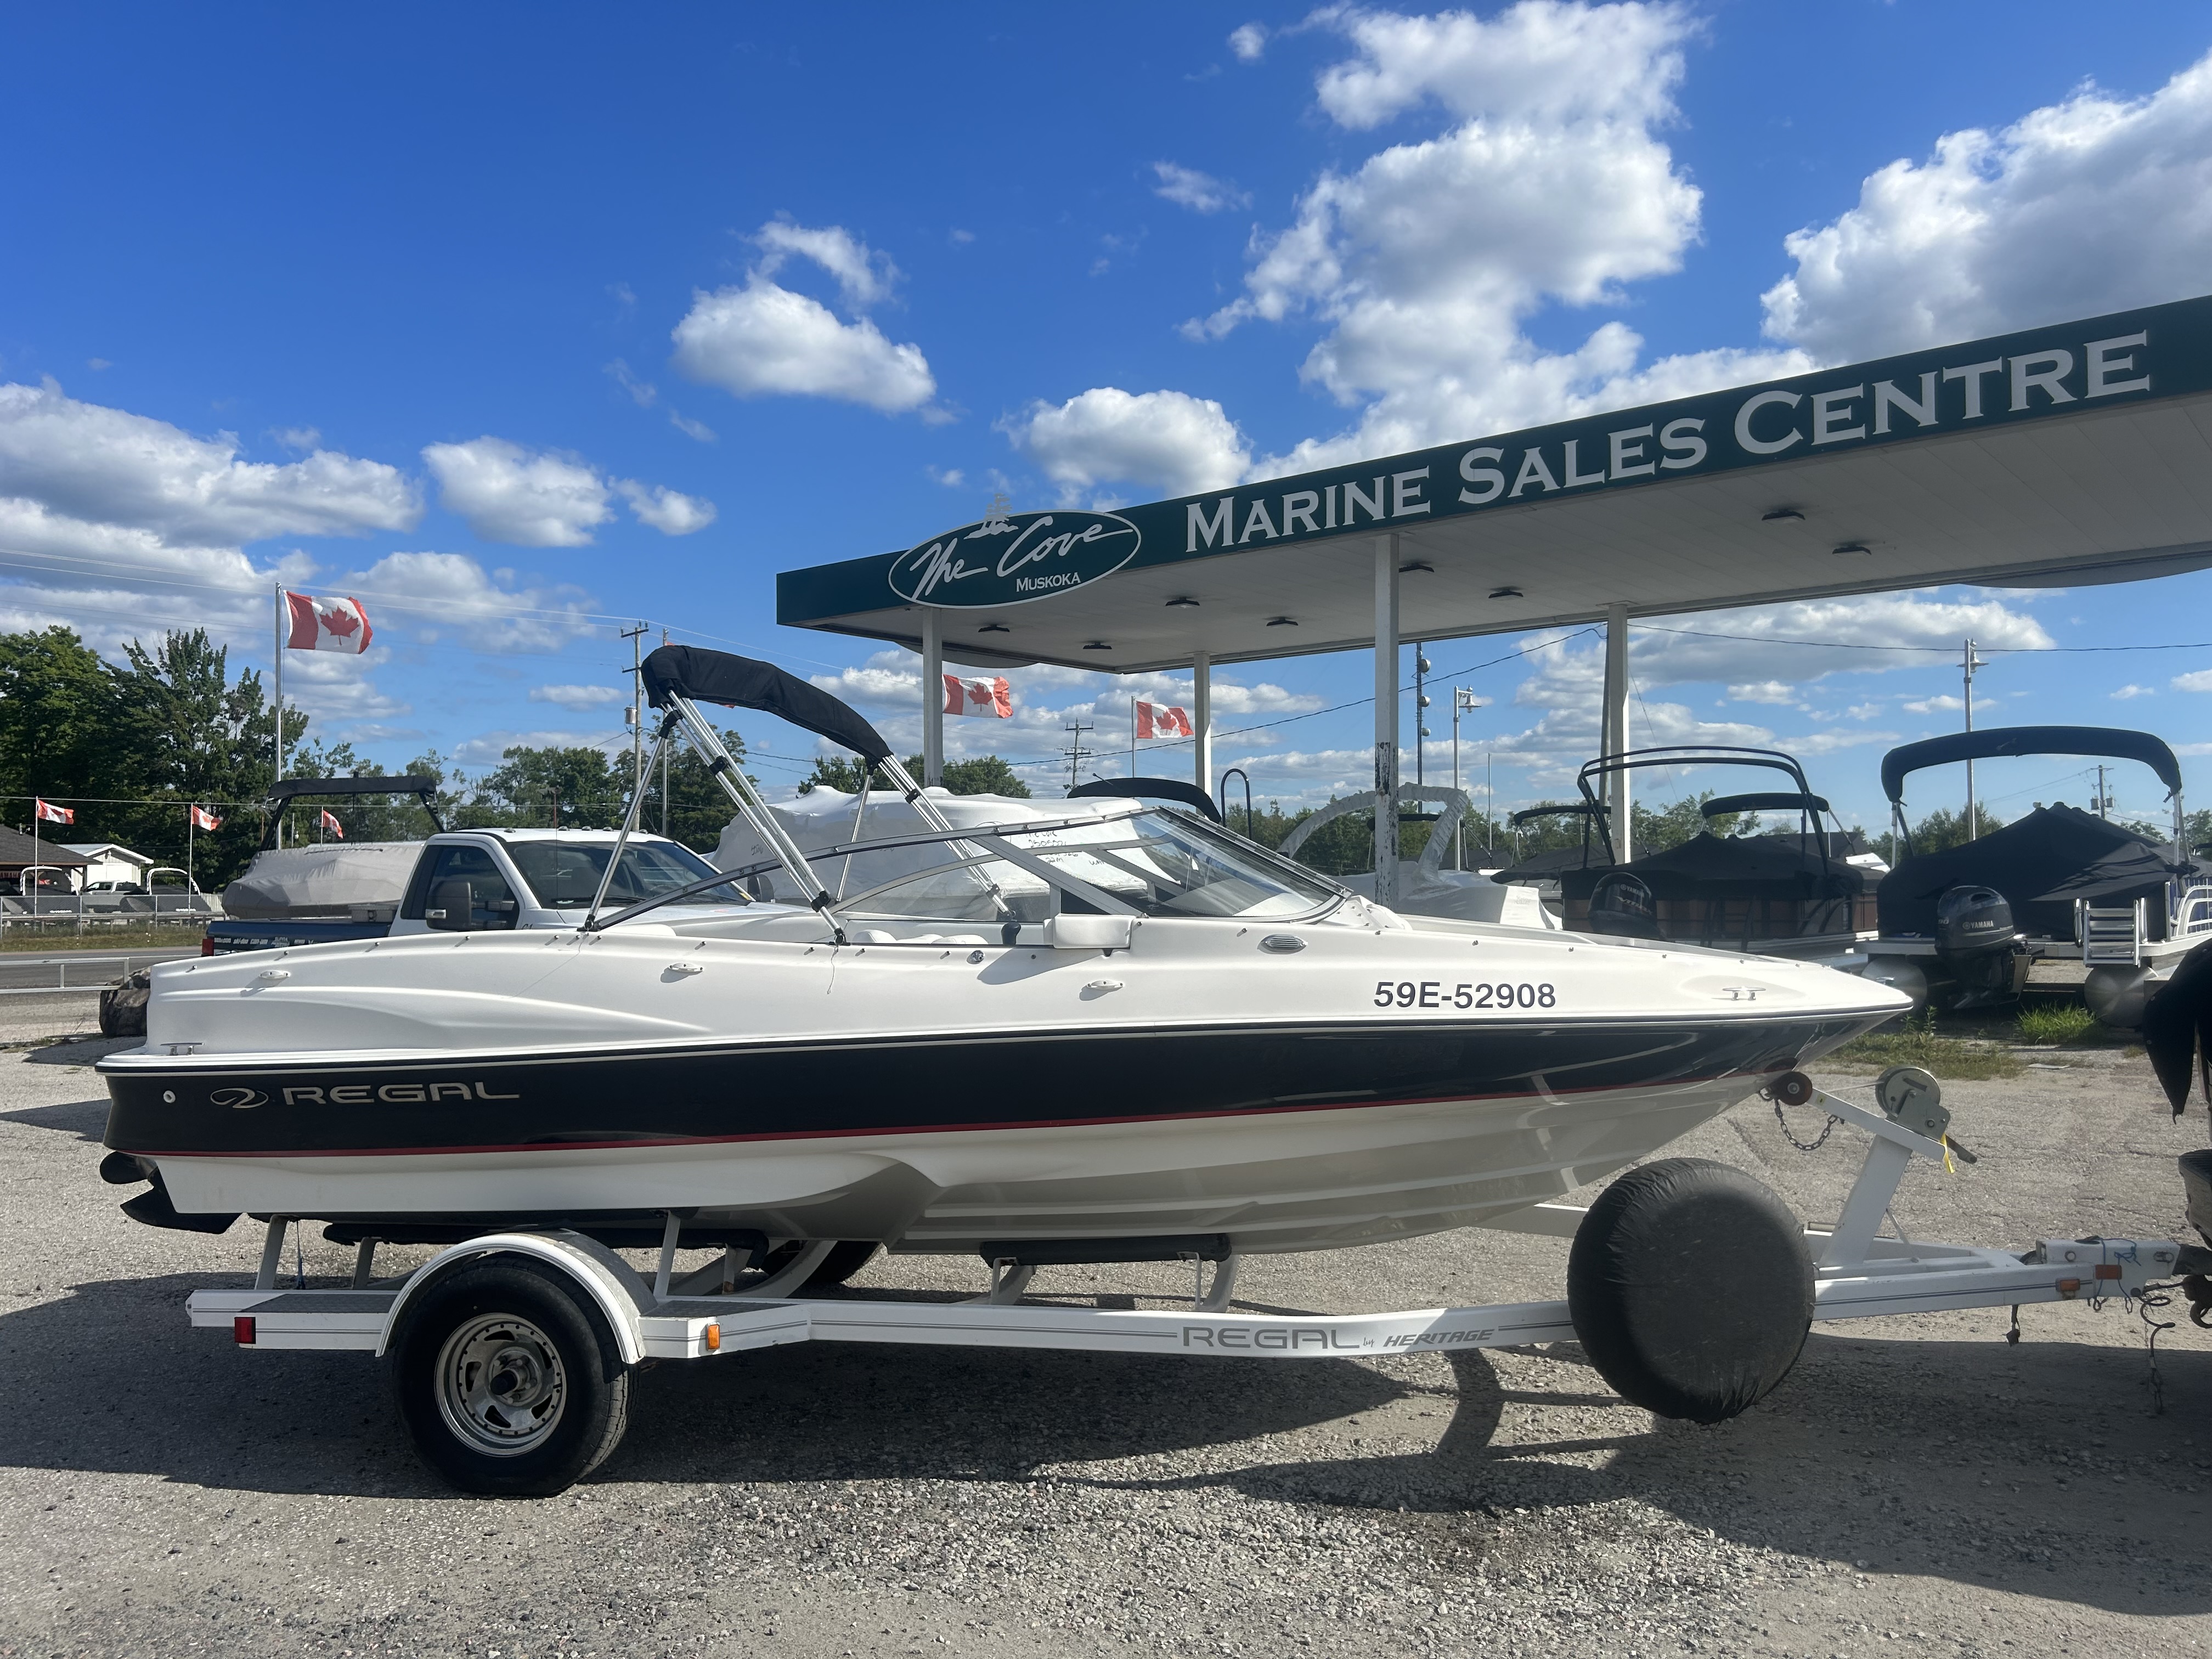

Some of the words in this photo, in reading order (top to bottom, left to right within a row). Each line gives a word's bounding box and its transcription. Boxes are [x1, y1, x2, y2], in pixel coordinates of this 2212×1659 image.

[1186, 465, 1430, 552] MARINE
[1458, 417, 1707, 504] SALES
[1734, 330, 2151, 454] CENTRE
[910, 538, 988, 601] The
[996, 516, 1133, 577] Cove
[1015, 572, 1081, 592] MUSKOKA
[1970, 920, 1994, 929] YAMAHA
[1373, 981, 1556, 1009] 59E-52908
[282, 1081, 520, 1105] REGAL
[1182, 1326, 1360, 1350] REGAL
[1383, 1328, 1496, 1347] HERITAGE
